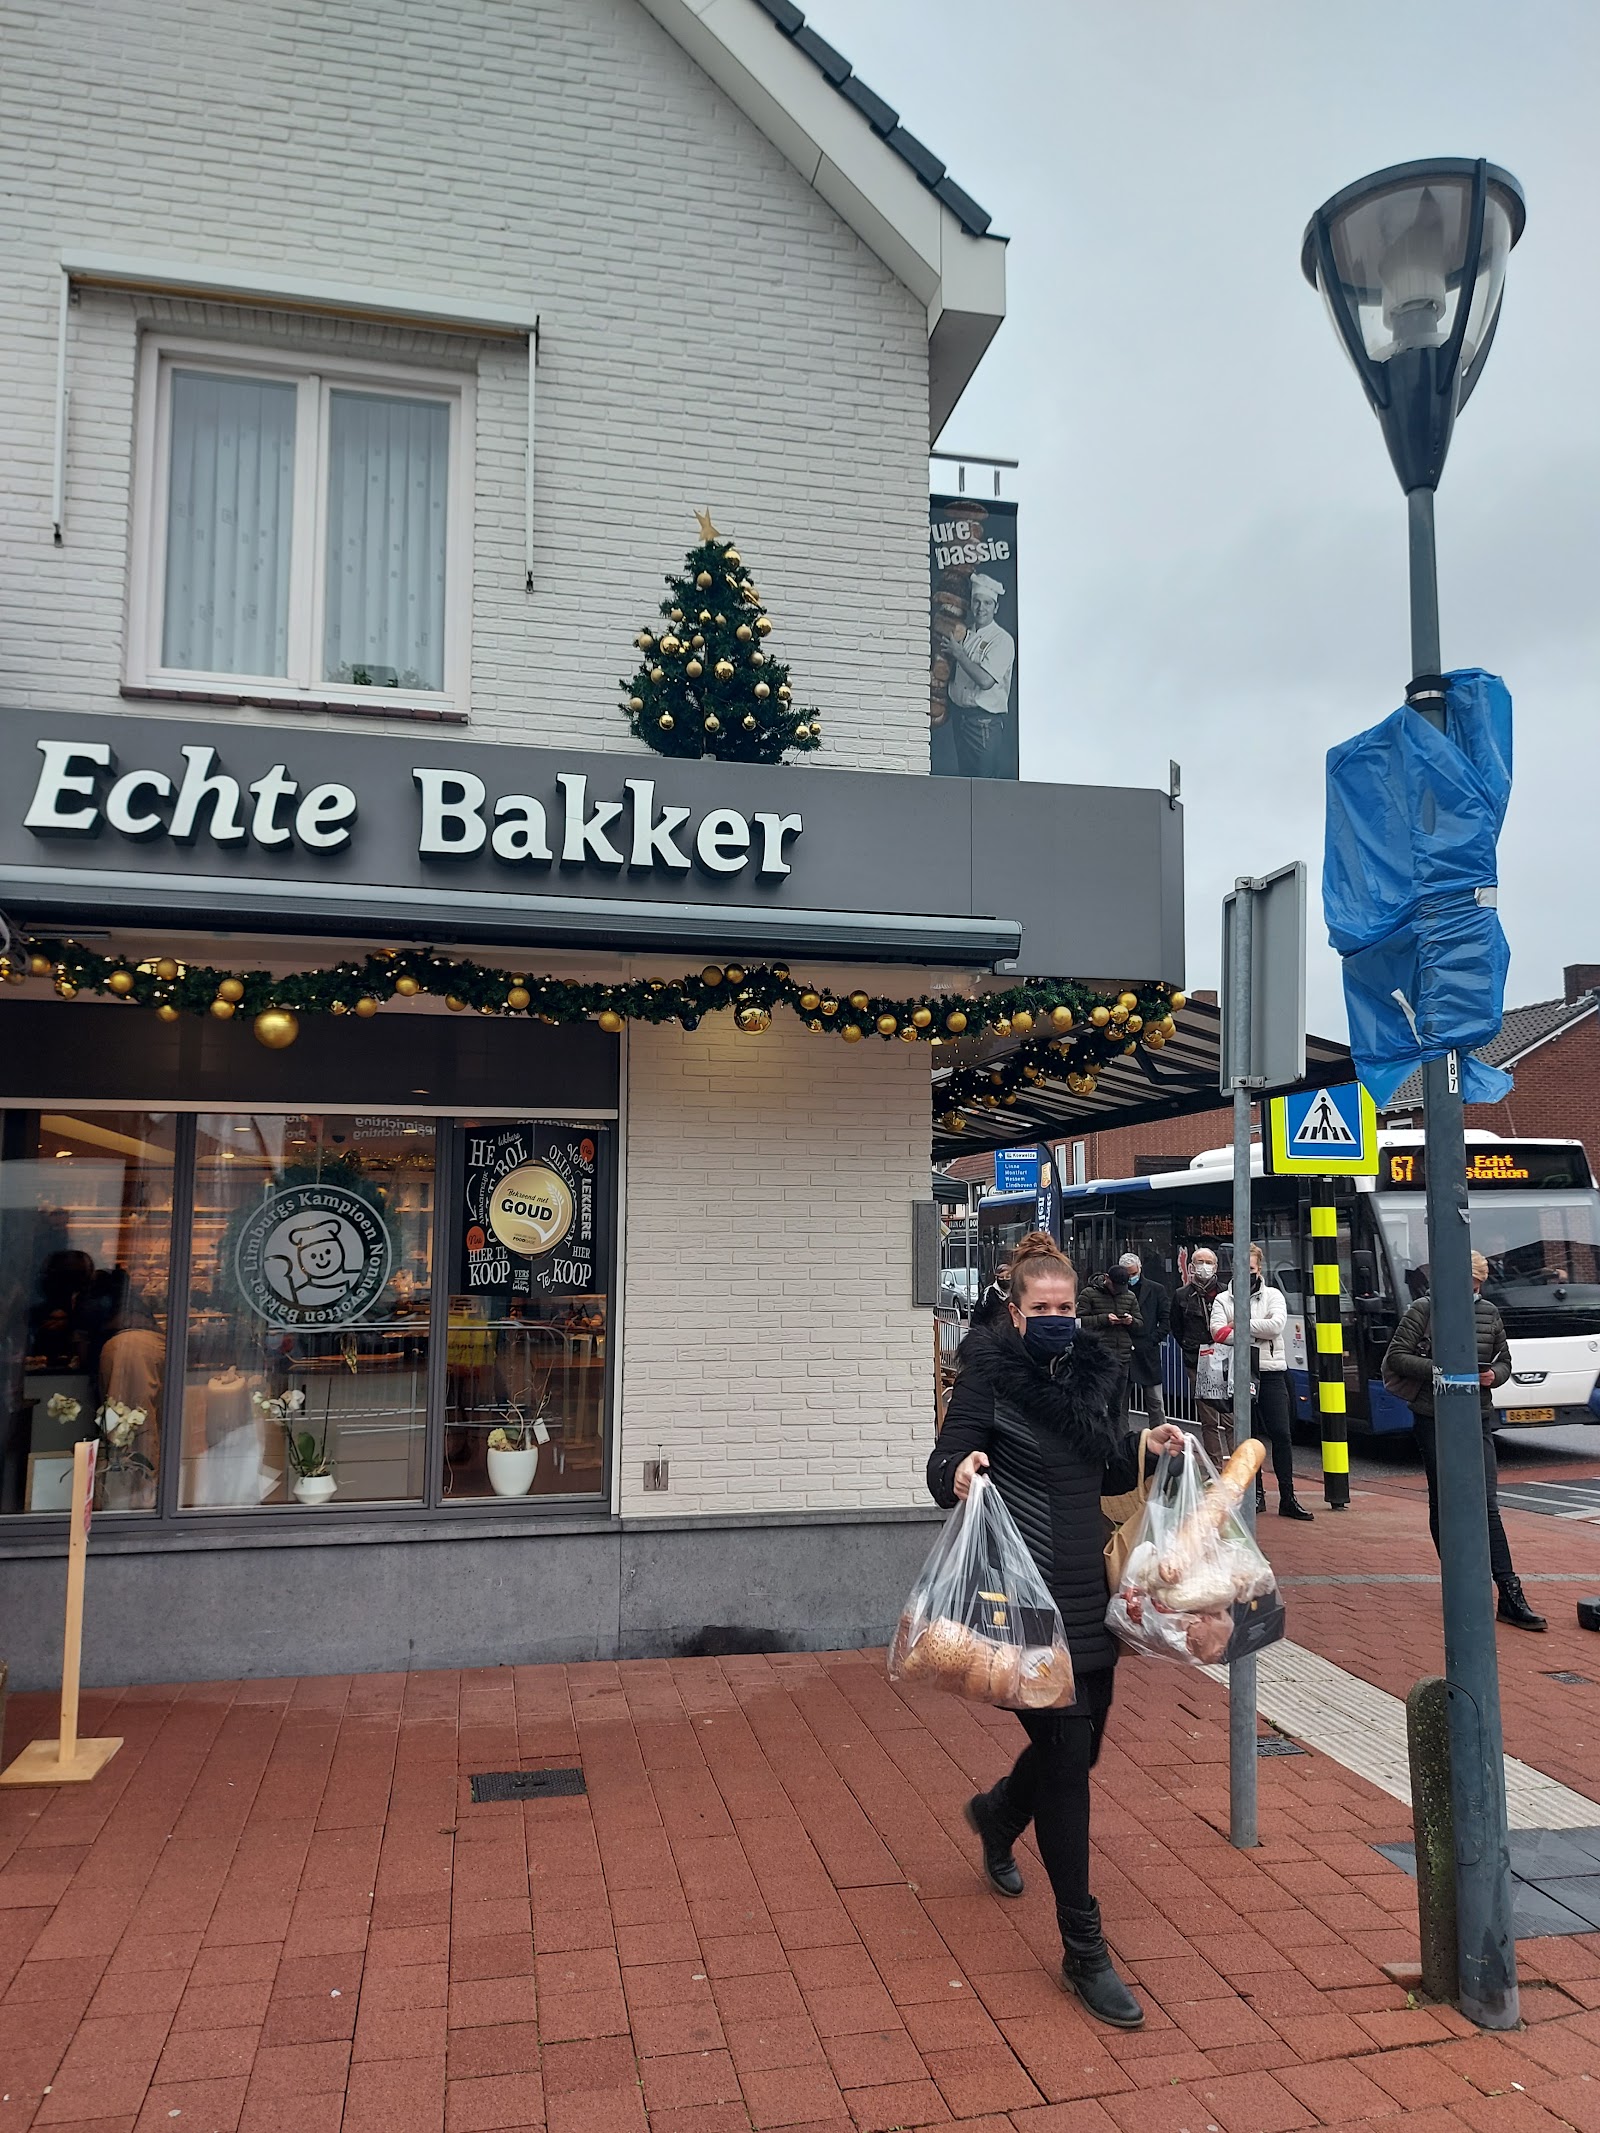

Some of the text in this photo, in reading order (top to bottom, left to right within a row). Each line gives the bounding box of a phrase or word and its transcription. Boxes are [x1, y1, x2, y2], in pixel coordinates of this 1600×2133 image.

[931, 521, 971, 543] ure
[935, 537, 1010, 570] passie
[23, 740, 802, 880] Echte Bakker
[468, 1138, 496, 1167] HÉ
[567, 1143, 595, 1174] Verse
[1391, 1154, 1513, 1182] 67 Echt
[1465, 1166, 1529, 1179] Station
[501, 1198, 553, 1221] GOUD
[581, 1177, 592, 1241] LEKKERE
[244, 1192, 384, 1323] Limburgs Kampioen Nonnevotten Bakker
[468, 1246, 508, 1263] HIER TE
[572, 1246, 591, 1259] HIER
[468, 1260, 511, 1287] KOOP
[514, 1270, 530, 1278] VERS
[537, 1258, 592, 1289] Te KOOP
[1515, 1373, 1544, 1382] VDL
